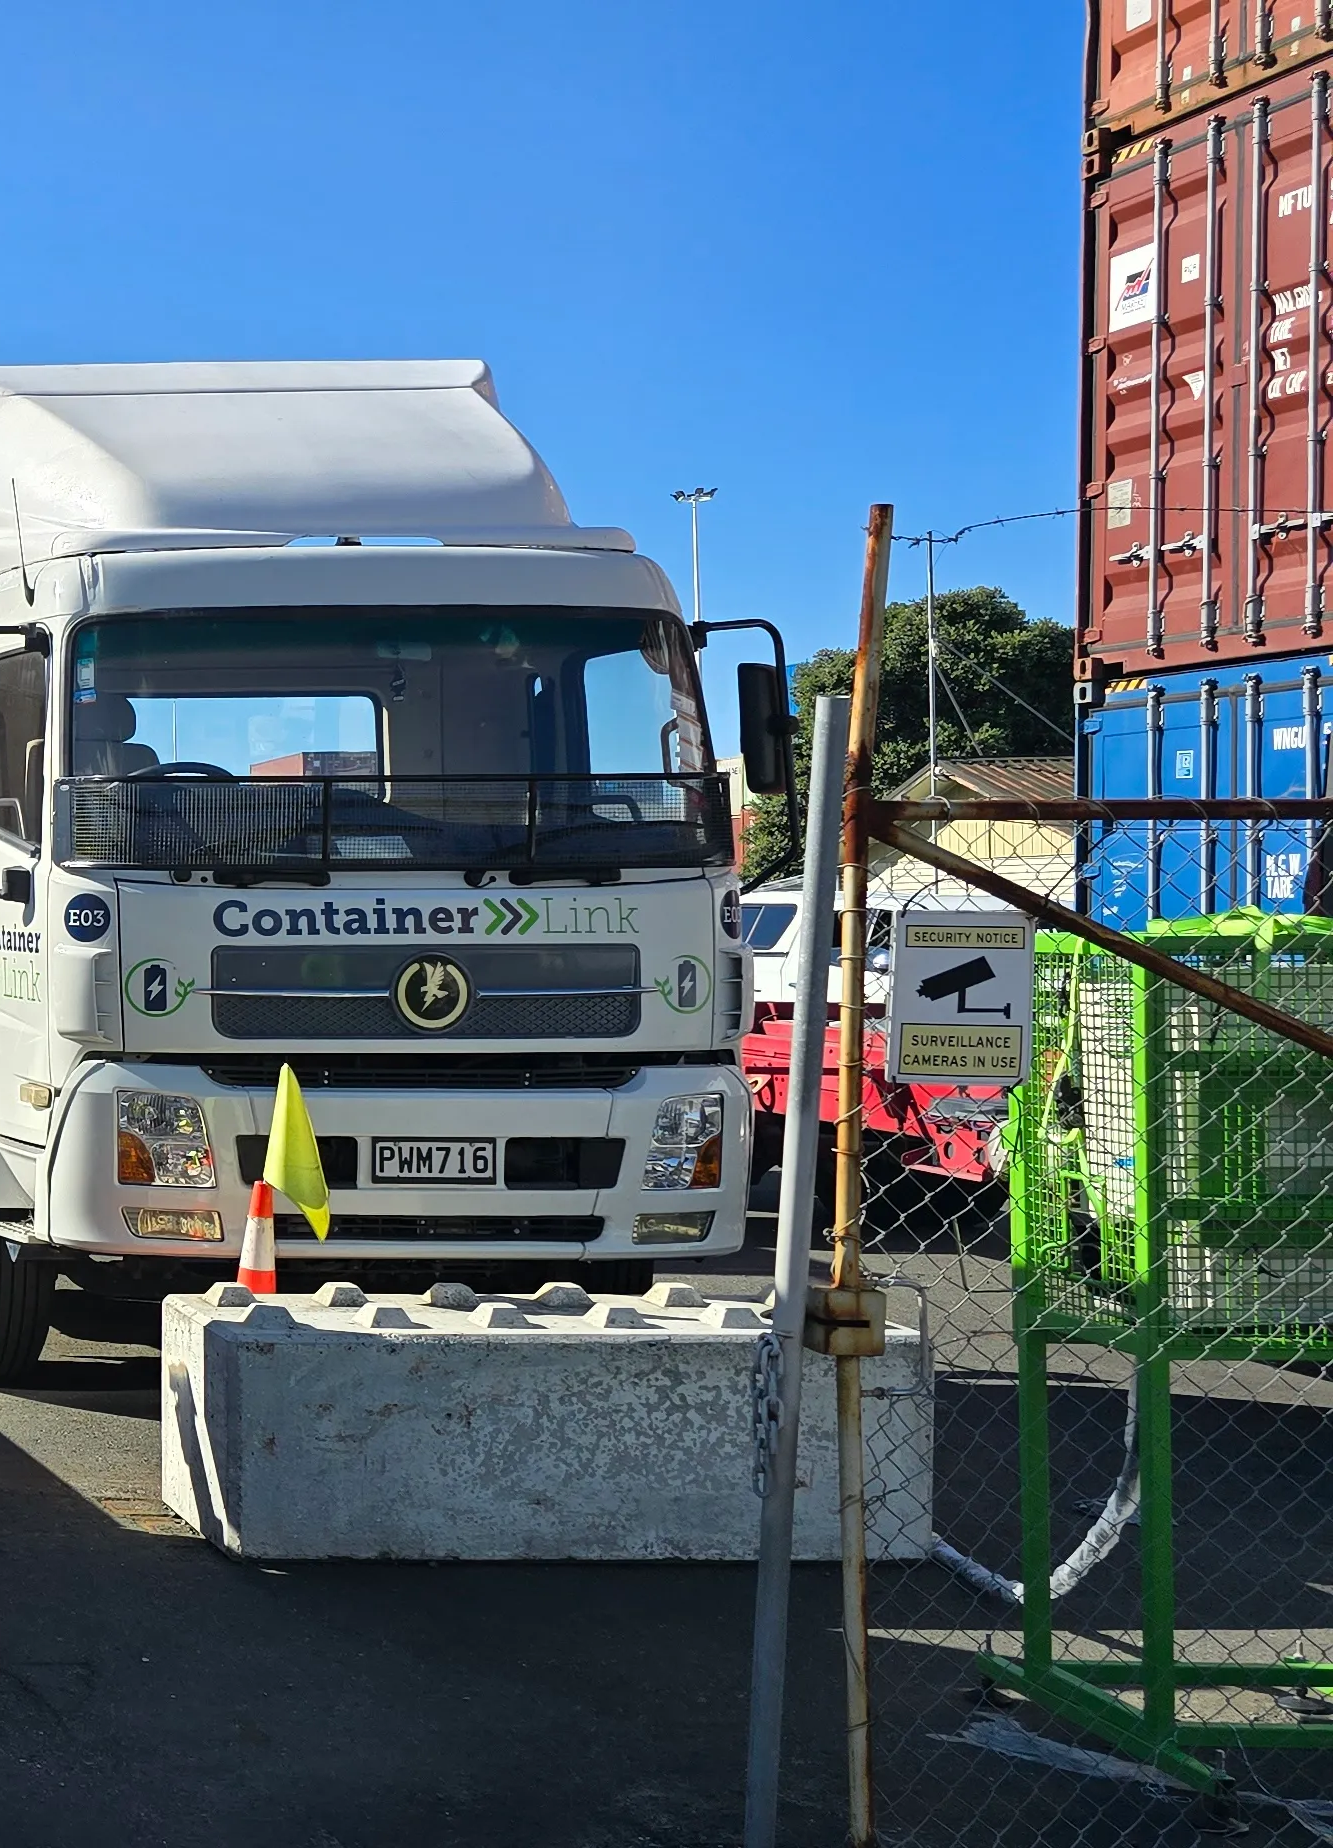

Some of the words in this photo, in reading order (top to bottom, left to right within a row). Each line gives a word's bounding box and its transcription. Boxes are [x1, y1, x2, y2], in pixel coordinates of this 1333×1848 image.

[68, 909, 105, 926] E03
[213, 897, 480, 937] Container
[542, 897, 640, 934] Link
[914, 932, 972, 943] SECURITY
[976, 932, 1018, 943] NOTICE
[2, 957, 41, 1002] Link
[911, 1034, 1011, 1049] SURVEILLANCE
[902, 1053, 968, 1067] CAMERAS
[973, 1056, 986, 1068] IN
[991, 1056, 1017, 1069] USE
[379, 1146, 489, 1174] PWM716
